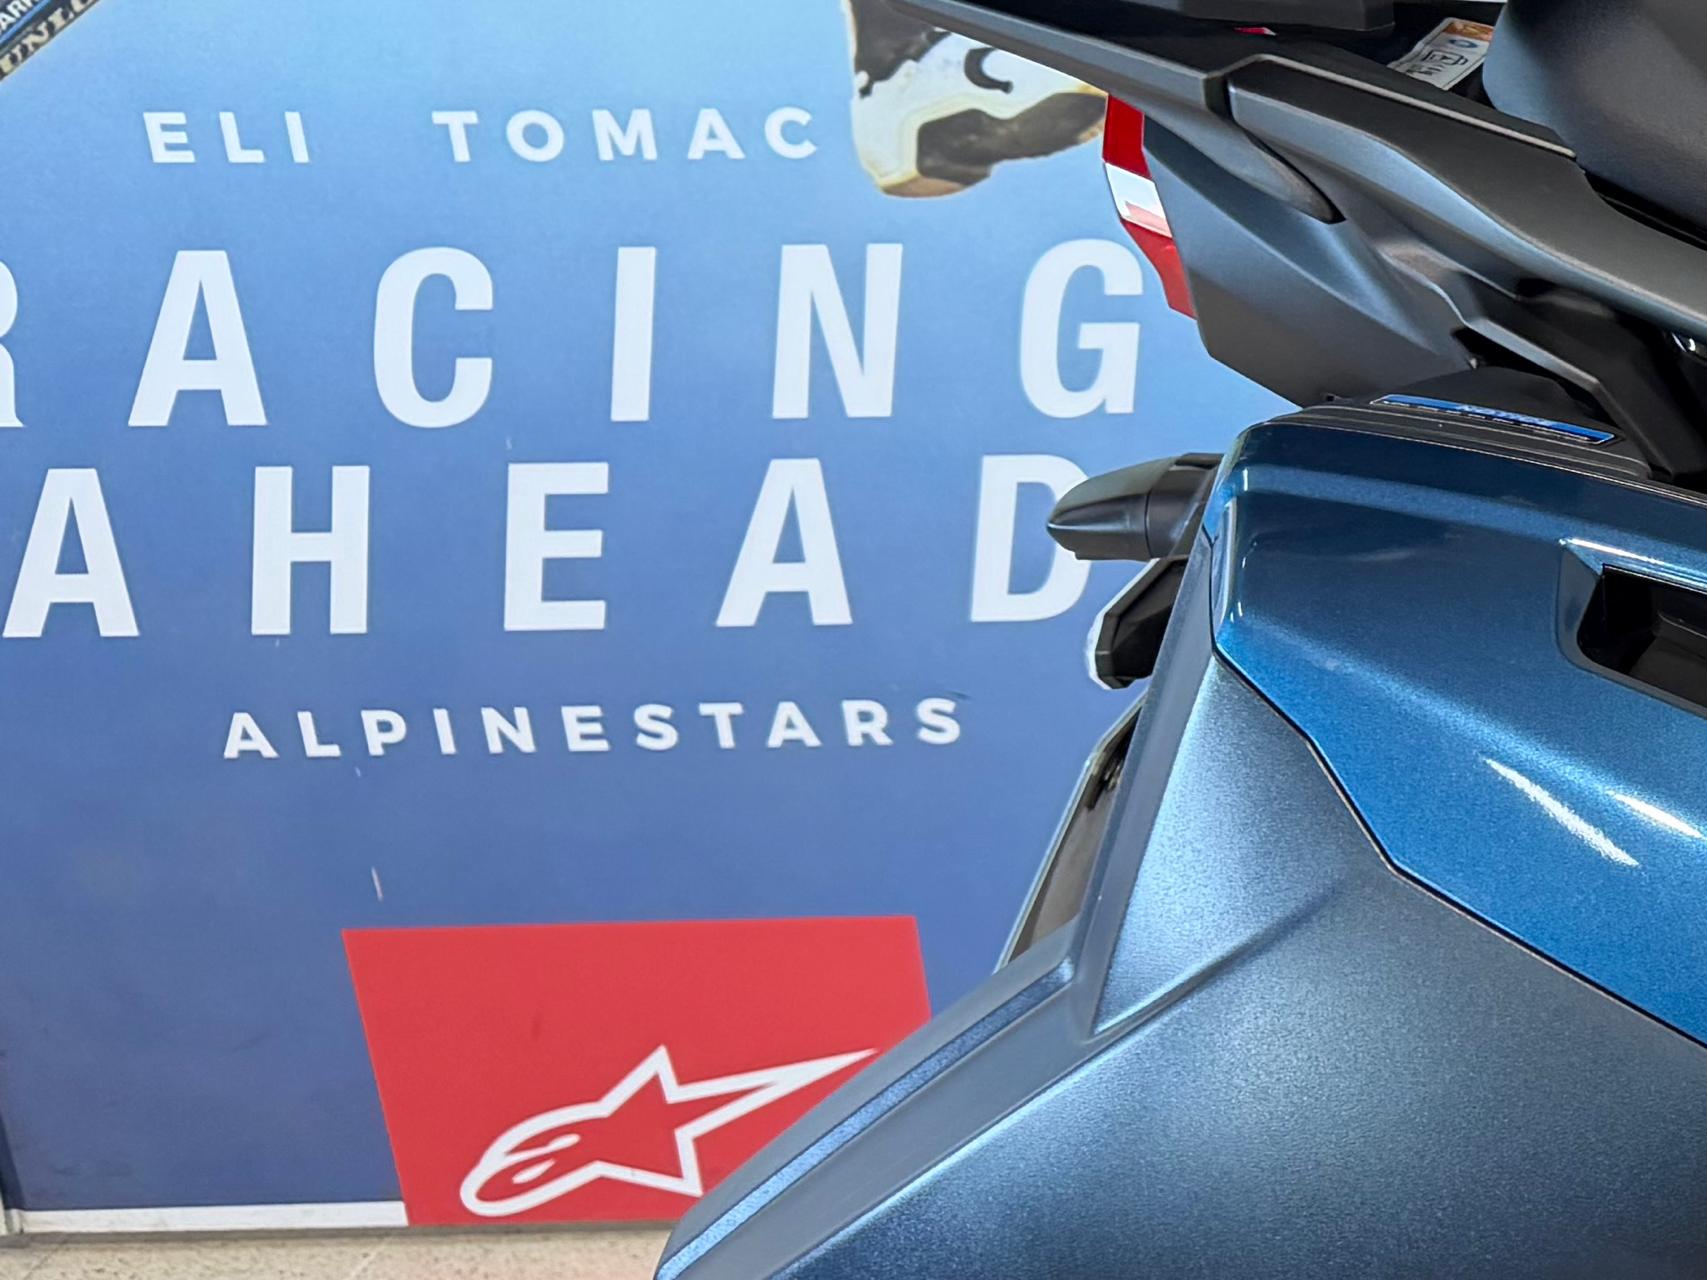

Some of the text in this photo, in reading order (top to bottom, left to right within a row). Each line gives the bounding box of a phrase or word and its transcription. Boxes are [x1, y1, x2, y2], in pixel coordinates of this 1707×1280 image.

[143, 107, 818, 164] ELI TOMAC
[0, 238, 1143, 428] ACING
[3, 454, 1091, 637] AHEAD
[222, 698, 961, 759] ALPINESTARS
